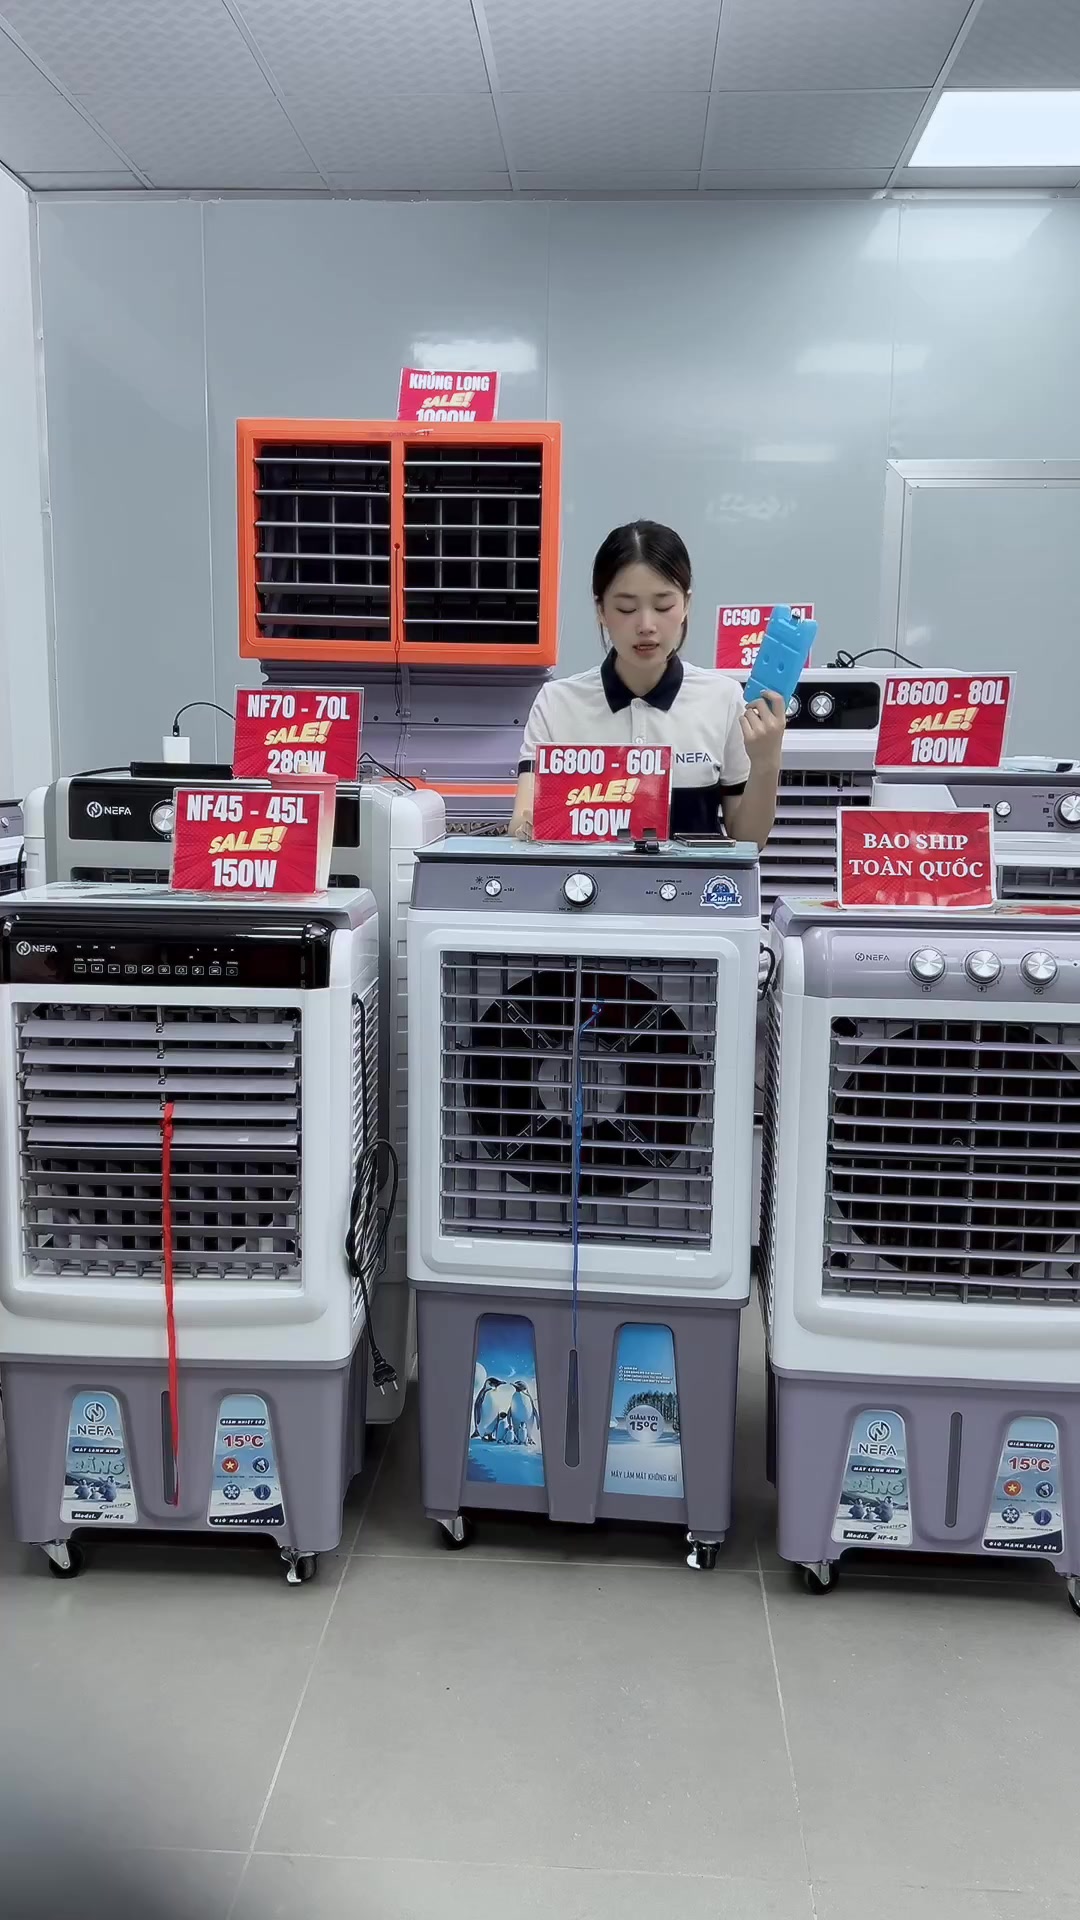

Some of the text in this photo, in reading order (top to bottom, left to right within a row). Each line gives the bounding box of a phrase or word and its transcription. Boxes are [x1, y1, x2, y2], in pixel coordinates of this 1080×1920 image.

[409, 371, 490, 391] KHỦNG LONG
[422, 392, 475, 408] SALE!
[722, 608, 760, 626] CC90
[886, 681, 948, 705] L8600
[968, 680, 1005, 705] 80L
[247, 694, 295, 719] NF70
[316, 696, 350, 720] 70L
[908, 707, 978, 734] SALE!
[264, 721, 332, 745] SALE!
[539, 749, 604, 774] L6800
[627, 749, 665, 775] 60L
[676, 752, 712, 763] NEFA
[911, 737, 969, 763] 180W
[565, 778, 640, 806] SALE!
[104, 806, 132, 815] NEFA
[187, 795, 243, 822] NF45
[265, 796, 308, 824] 45L
[569, 808, 631, 836] 160W
[208, 826, 288, 854] SALE!
[863, 833, 969, 850] BAO SHIP
[212, 859, 277, 888] 150W
[849, 856, 984, 881] TOÀN QUỐC
[710, 893, 717, 901] 2
[32, 944, 57, 953] NEFA
[77, 1424, 114, 1437] NEFA
[859, 1443, 896, 1455] NEFA
